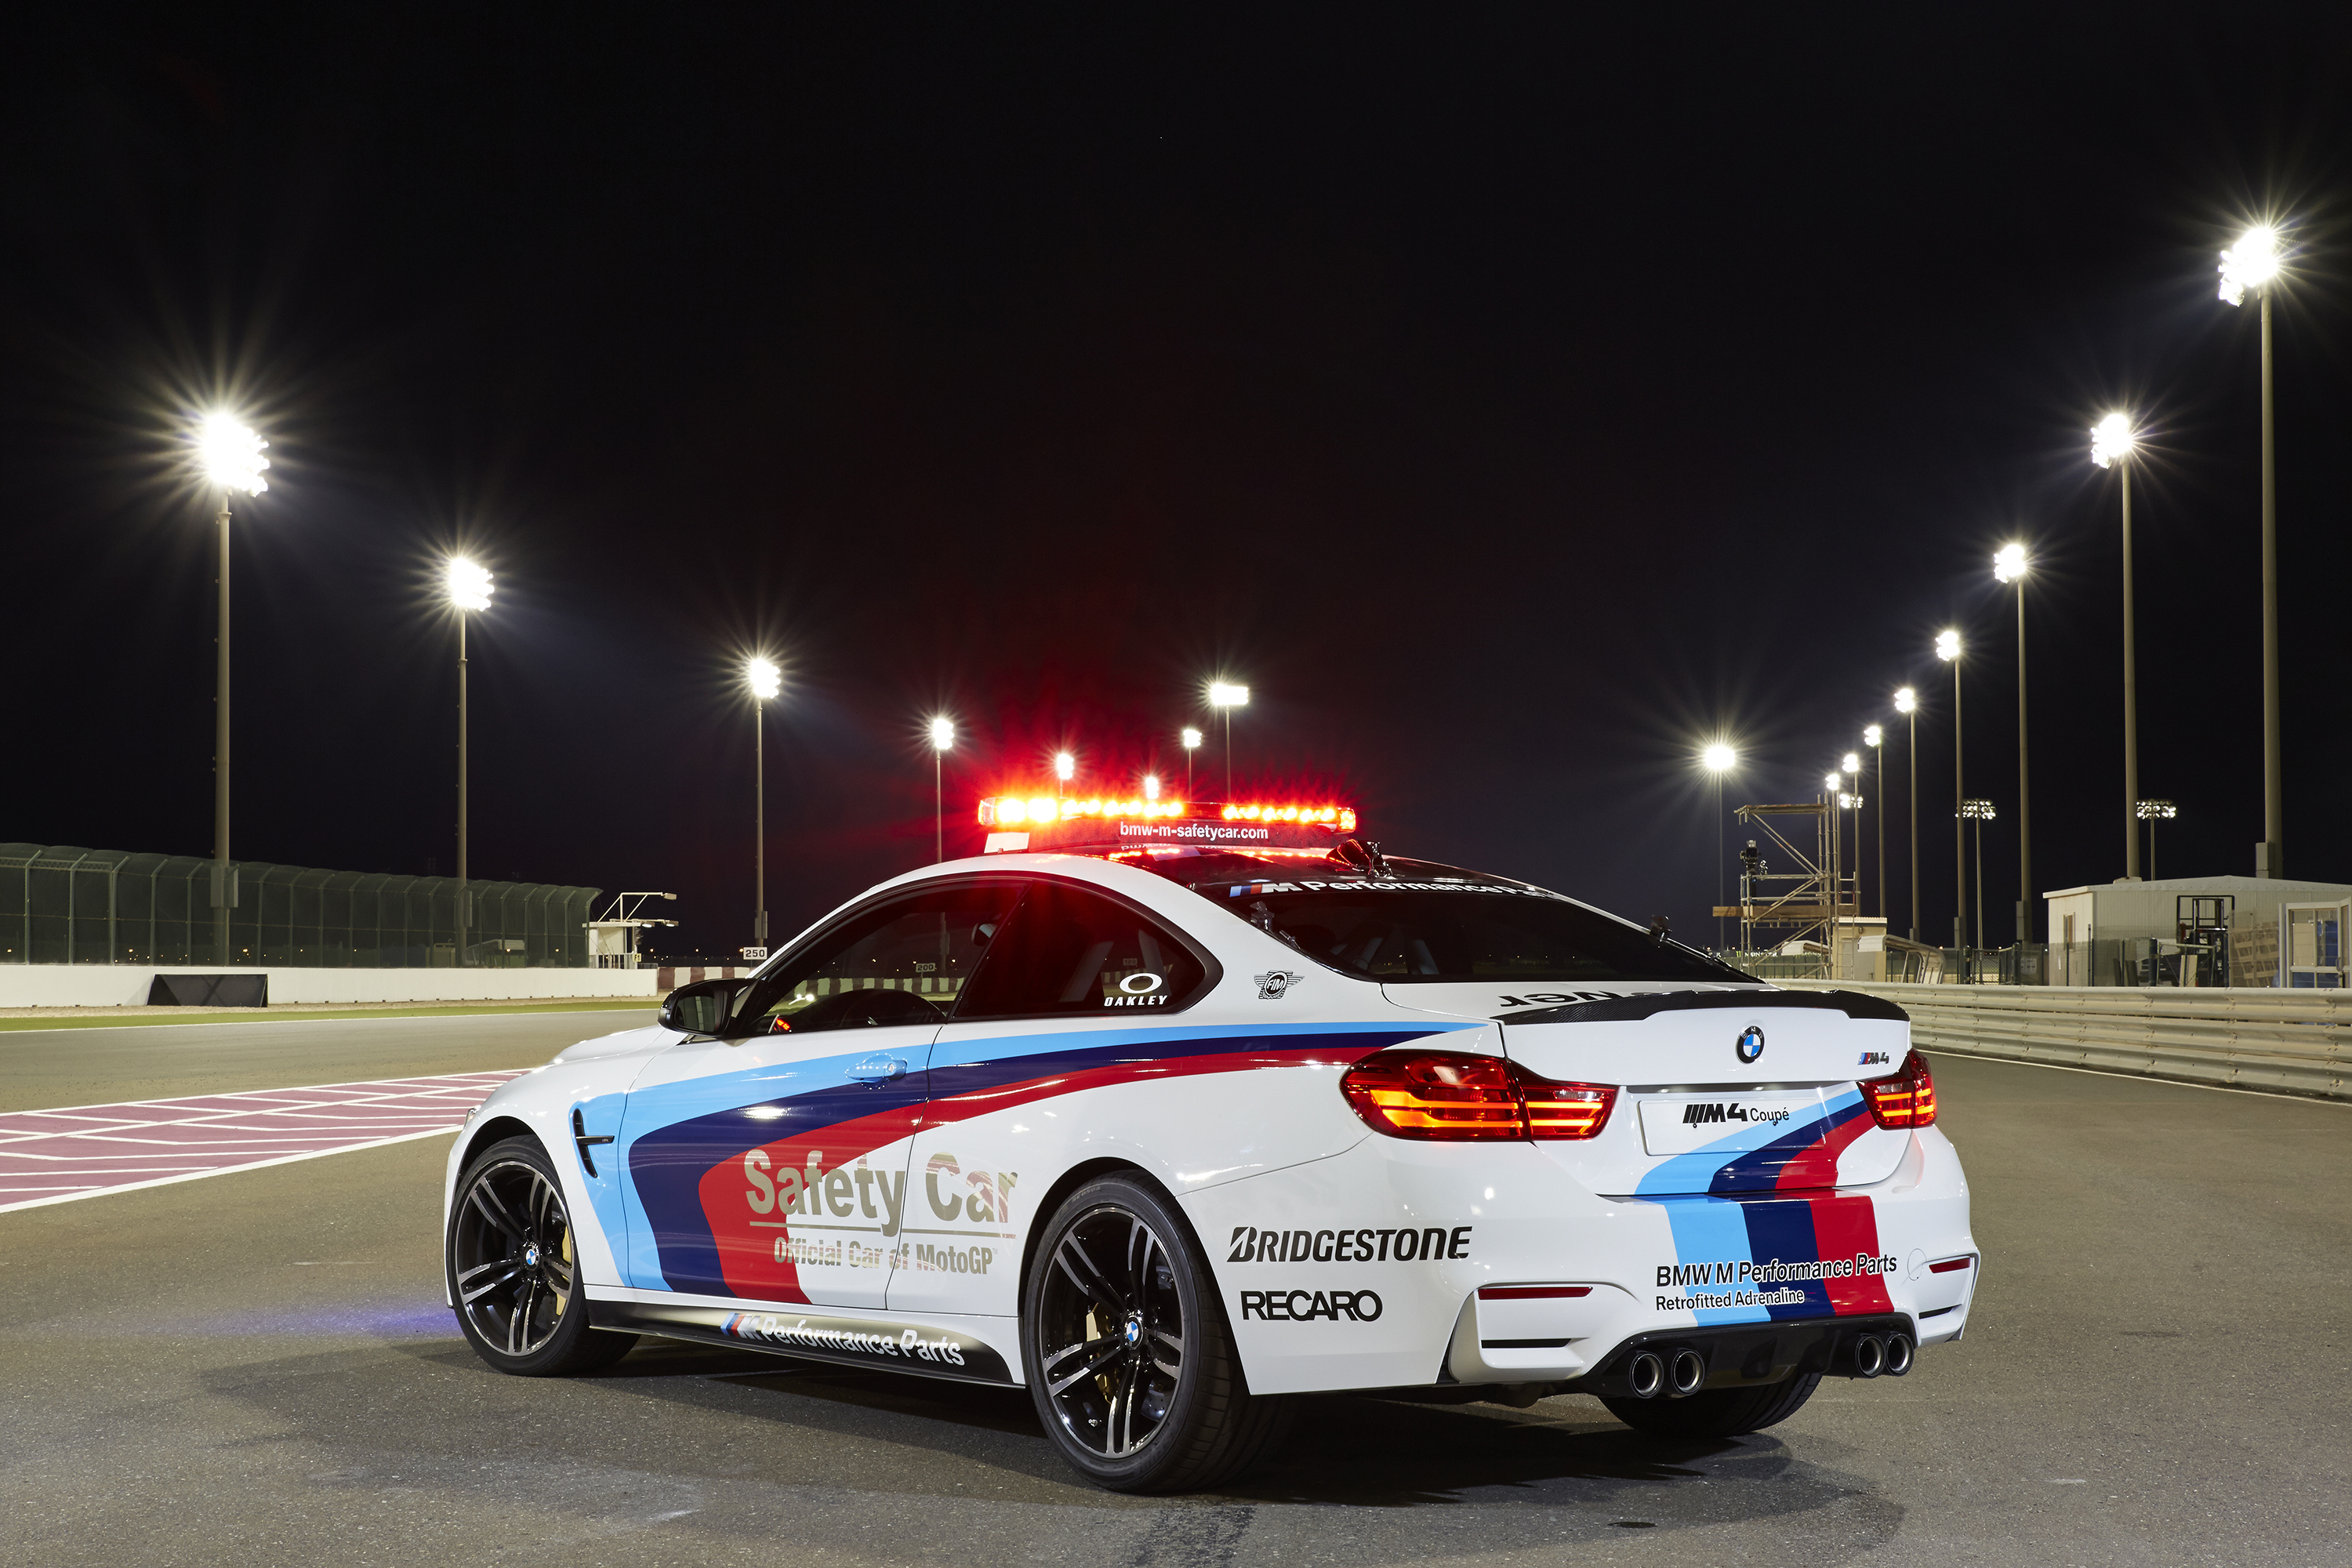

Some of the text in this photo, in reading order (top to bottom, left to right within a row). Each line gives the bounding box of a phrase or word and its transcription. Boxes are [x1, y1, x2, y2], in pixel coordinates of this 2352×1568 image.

[1120, 821, 1269, 841] bmw-m-safetycar.com
[1299, 880, 1503, 894] Performance
[745, 949, 766, 958] 250
[1266, 978, 1285, 991] FIM
[1103, 994, 1169, 1007] OAKLEY
[1749, 1106, 1790, 1124] Coupé
[744, 1149, 1019, 1237] Safety Car
[774, 1236, 842, 1267] Official
[848, 1240, 884, 1269] Car
[888, 1243, 910, 1271] of
[1226, 1225, 1474, 1263] BRIDGESTONE
[1656, 1252, 1898, 1287] BMW M Performance Parts
[1240, 1289, 1383, 1323] RECARO
[1656, 1287, 1806, 1311] Retrofitted Adrenaline
[734, 1314, 966, 1367] M Performance Parts
